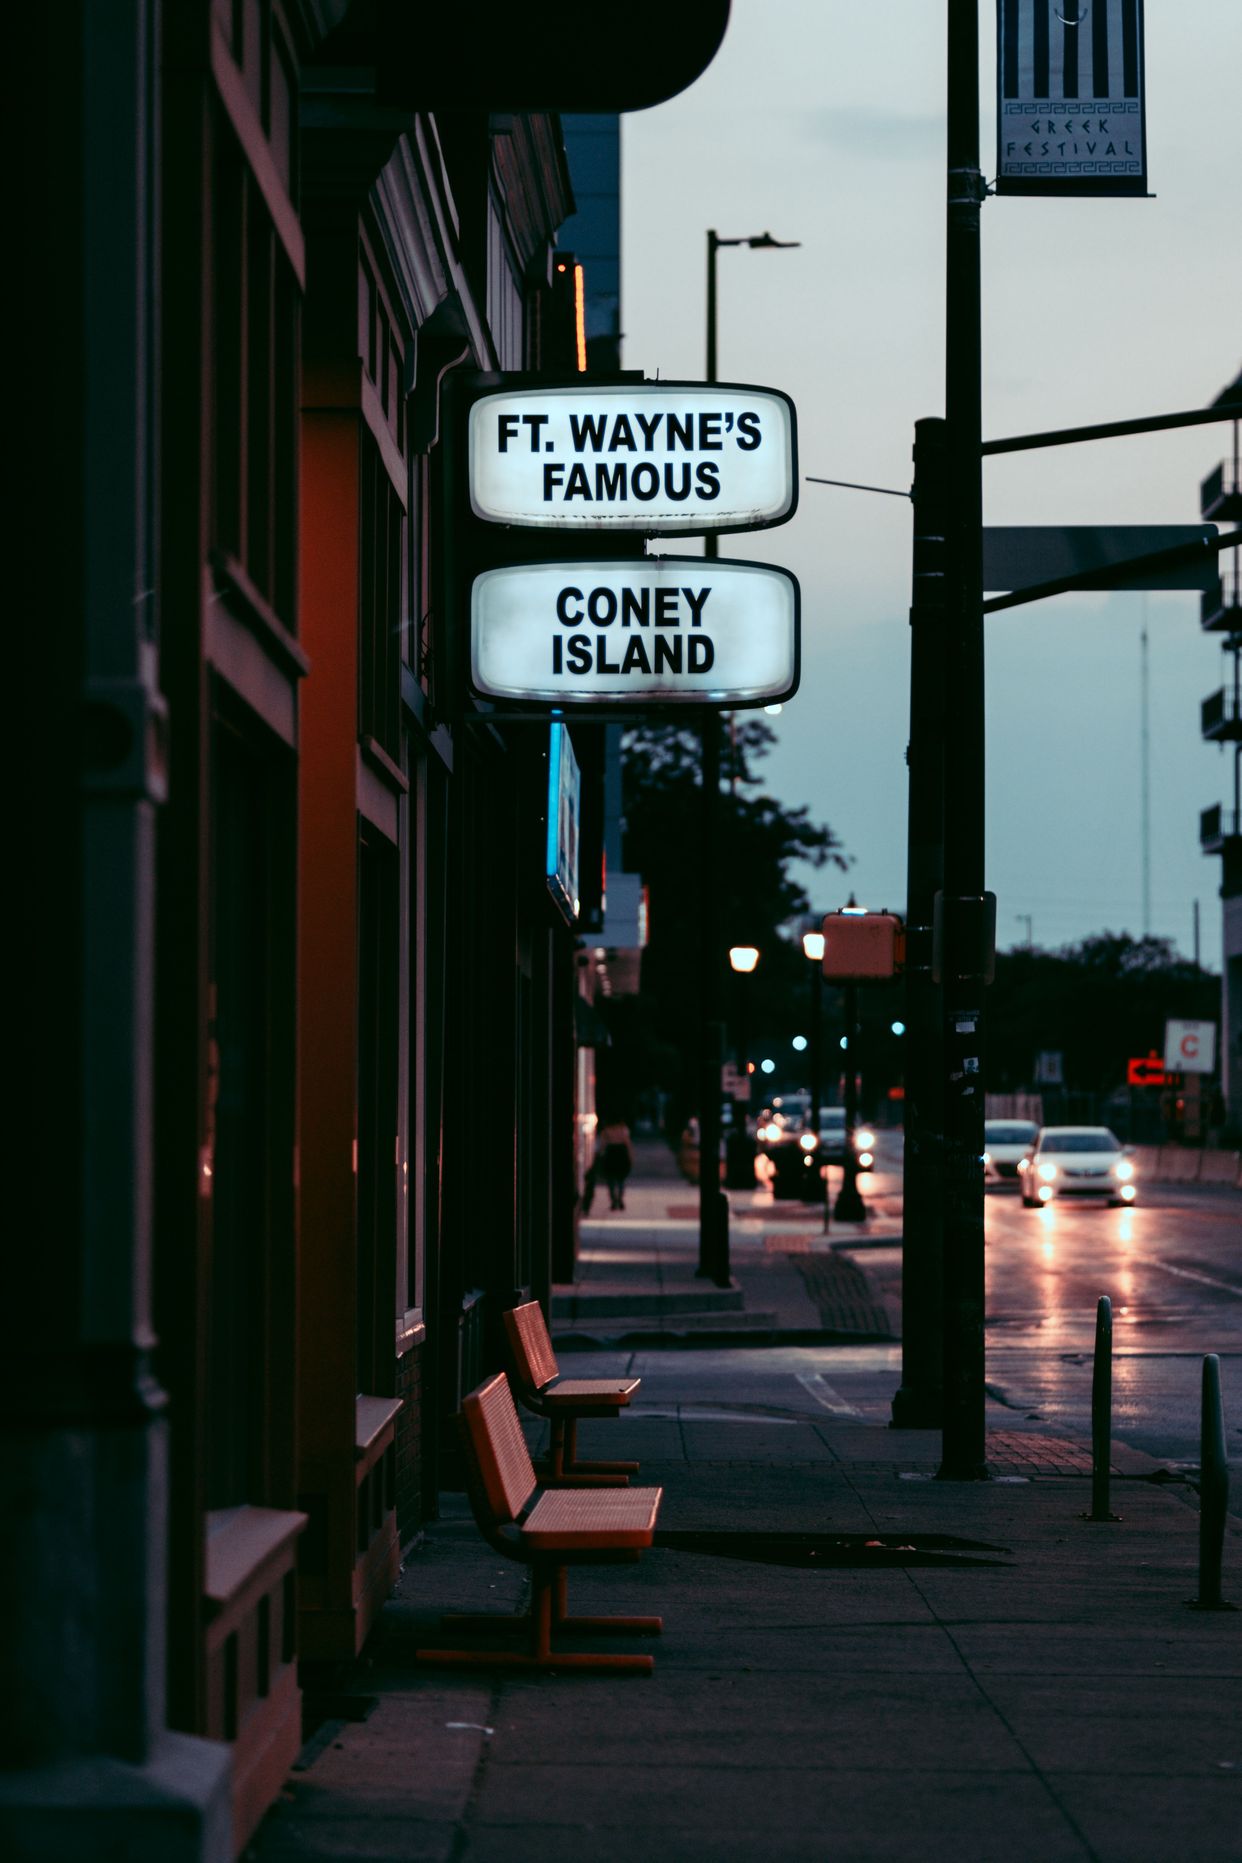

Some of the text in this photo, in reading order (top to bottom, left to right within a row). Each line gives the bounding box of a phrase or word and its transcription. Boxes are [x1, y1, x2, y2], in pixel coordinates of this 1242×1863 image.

[1031, 119, 1109, 134] GREEK
[1006, 141, 1133, 156] FESTIVAL
[498, 412, 762, 453] FT. WAYNE'S
[543, 462, 720, 501] FAMOUS
[556, 587, 712, 627] CONEY
[552, 634, 715, 675] ISLAND
